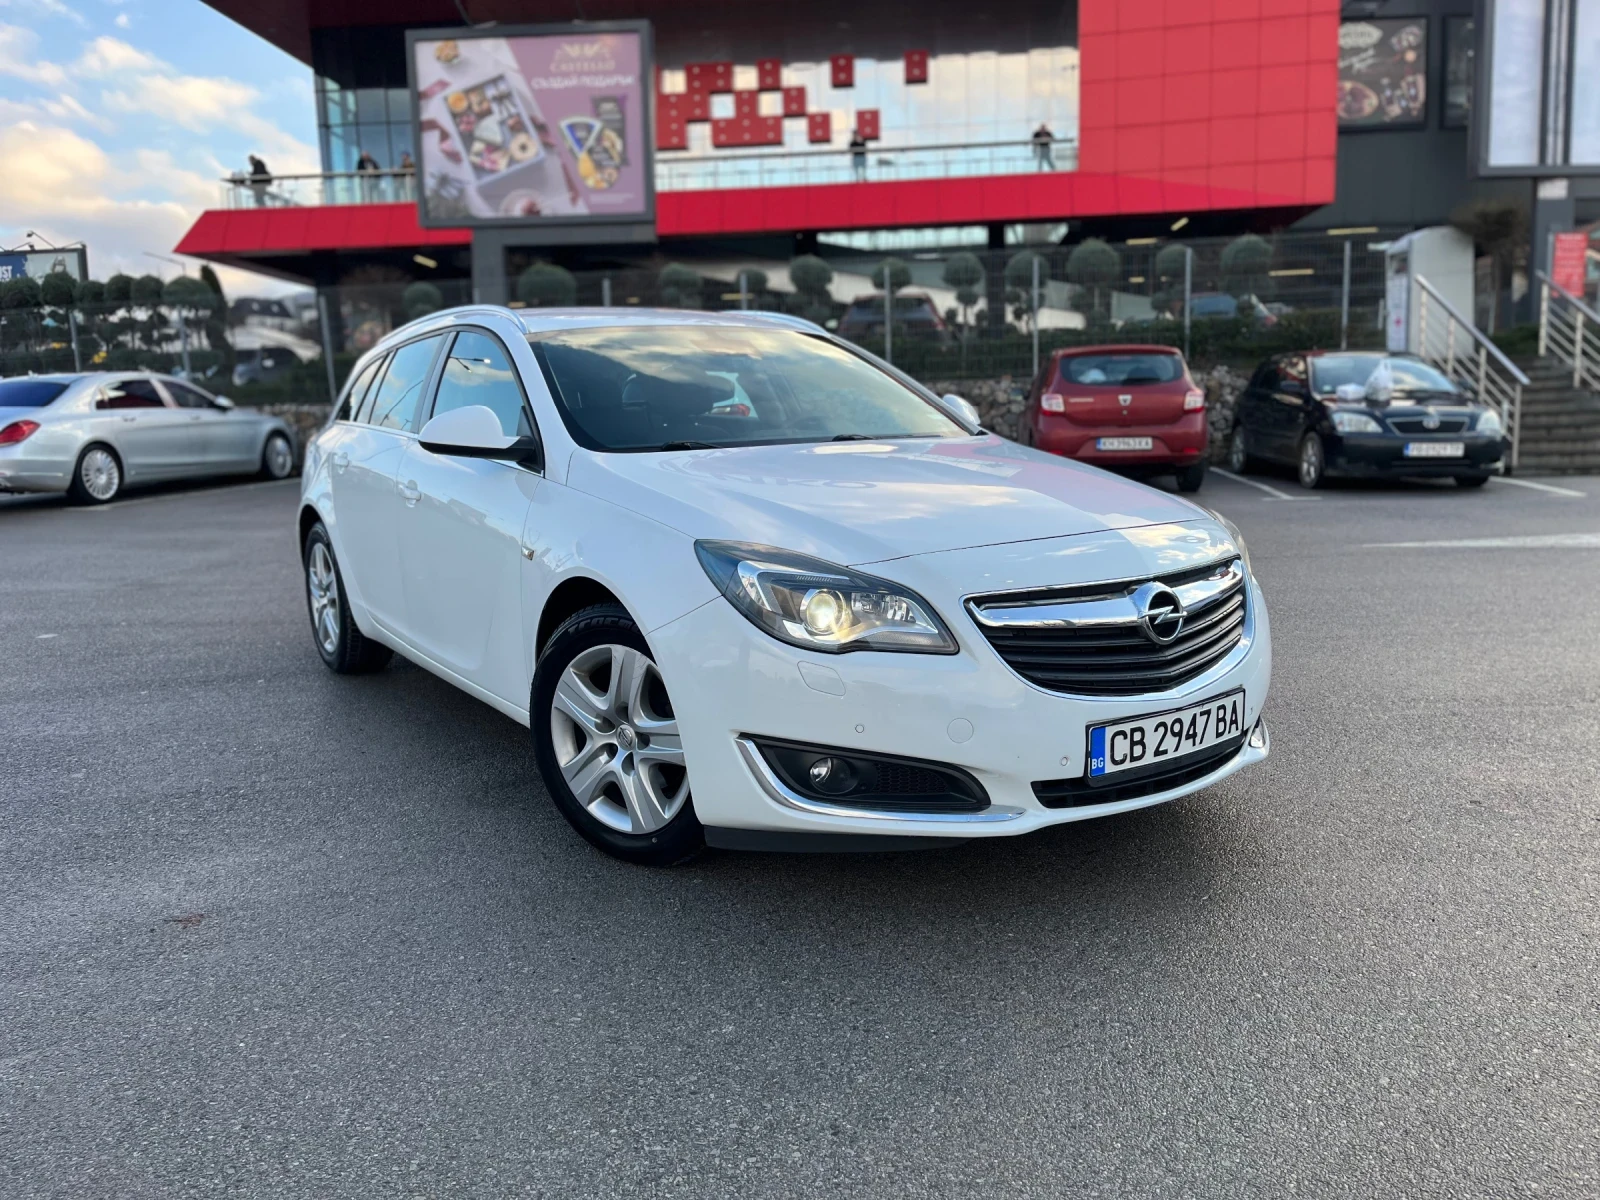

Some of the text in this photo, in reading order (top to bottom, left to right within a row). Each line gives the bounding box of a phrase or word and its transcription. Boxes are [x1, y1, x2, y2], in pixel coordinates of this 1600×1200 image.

[1109, 699, 1239, 766] CB 2947 BA
[1091, 757, 1104, 770] BG
